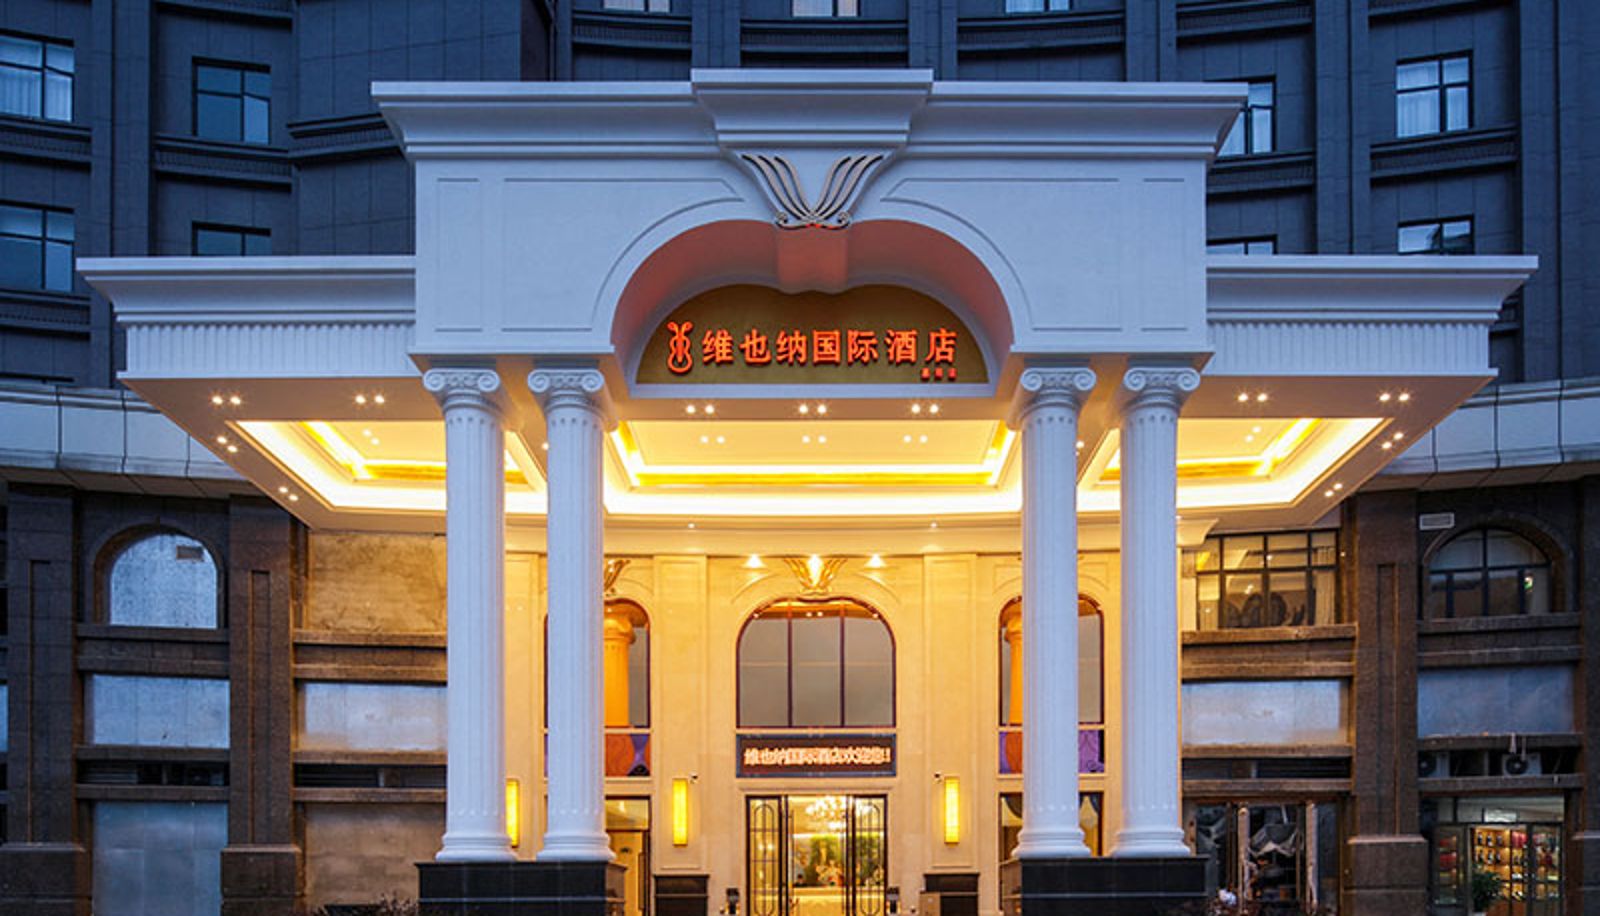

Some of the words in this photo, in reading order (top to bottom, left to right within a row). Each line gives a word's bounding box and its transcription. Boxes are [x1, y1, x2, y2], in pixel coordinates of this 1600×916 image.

[702, 328, 957, 365] 维也纳国际酒店
